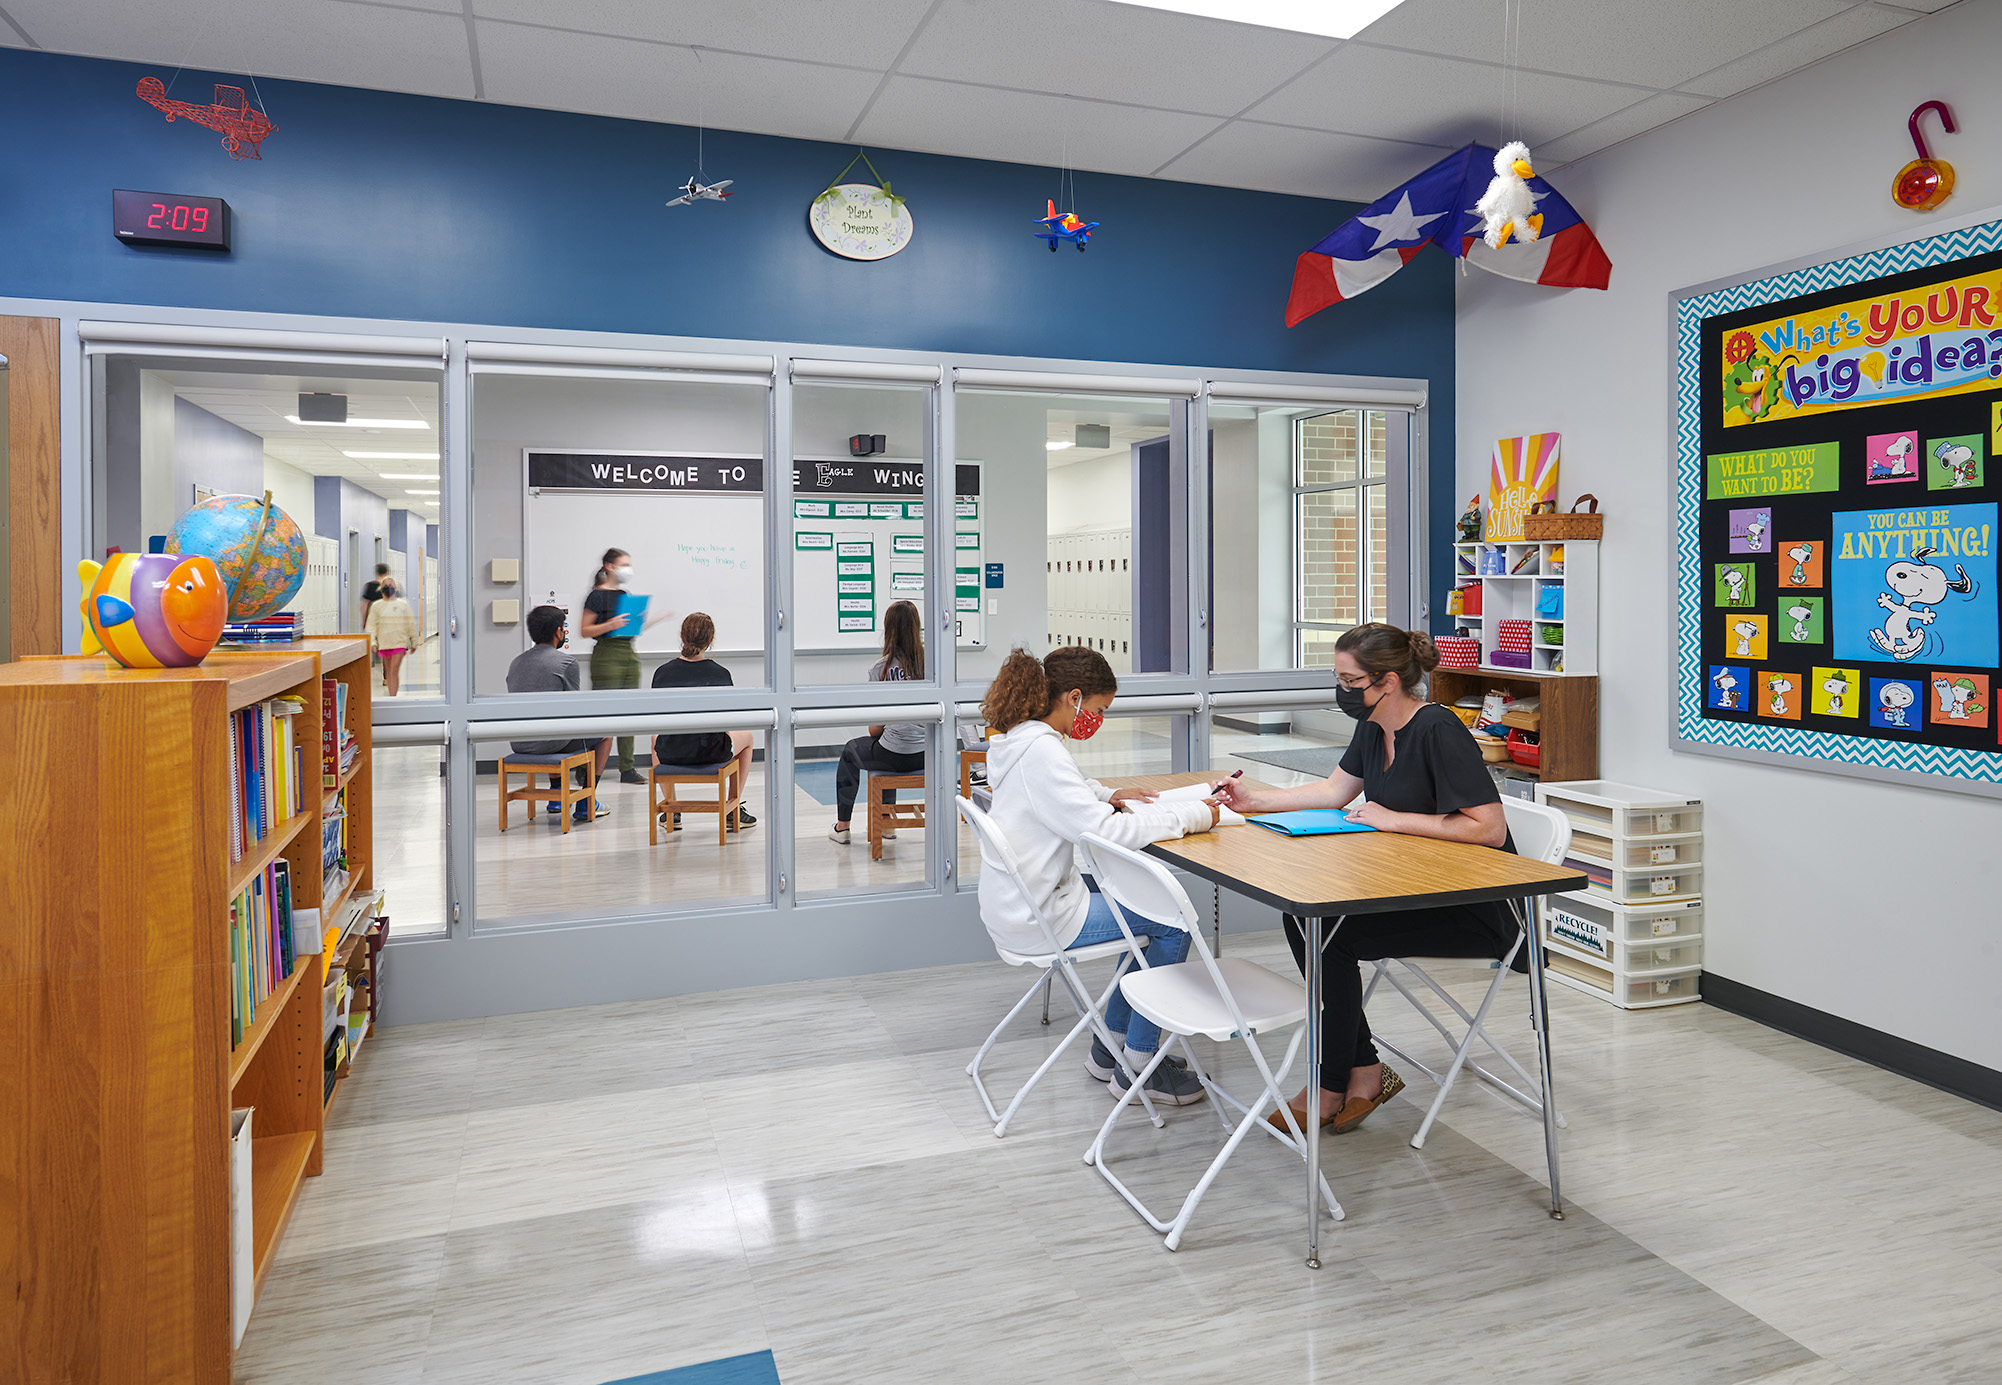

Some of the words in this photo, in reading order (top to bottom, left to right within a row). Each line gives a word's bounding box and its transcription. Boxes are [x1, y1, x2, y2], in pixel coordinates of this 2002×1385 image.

[148, 203, 209, 233] 2:09
[846, 205, 874, 219] Plant
[842, 222, 879, 235] Dreams
[1759, 311, 1861, 355] What's
[1785, 354, 1861, 409] big
[1888, 329, 2002, 384] idea?
[591, 463, 698, 486] WELCOME
[718, 466, 746, 485] TO
[1719, 453, 1766, 477] WHAT
[1770, 452, 1786, 468] DO
[1790, 448, 1816, 466] YOU
[1721, 477, 1758, 496] WANT
[1761, 476, 1777, 493] TO
[1780, 467, 1814, 491] BE?
[1487, 507, 1540, 538] SUNSH
[1867, 513, 1895, 529] YOU
[1897, 511, 1927, 527] CAN
[1930, 510, 1950, 526] BE
[1838, 524, 1990, 559] ANYTHING!
[1559, 913, 1598, 936] RECYCLE!
